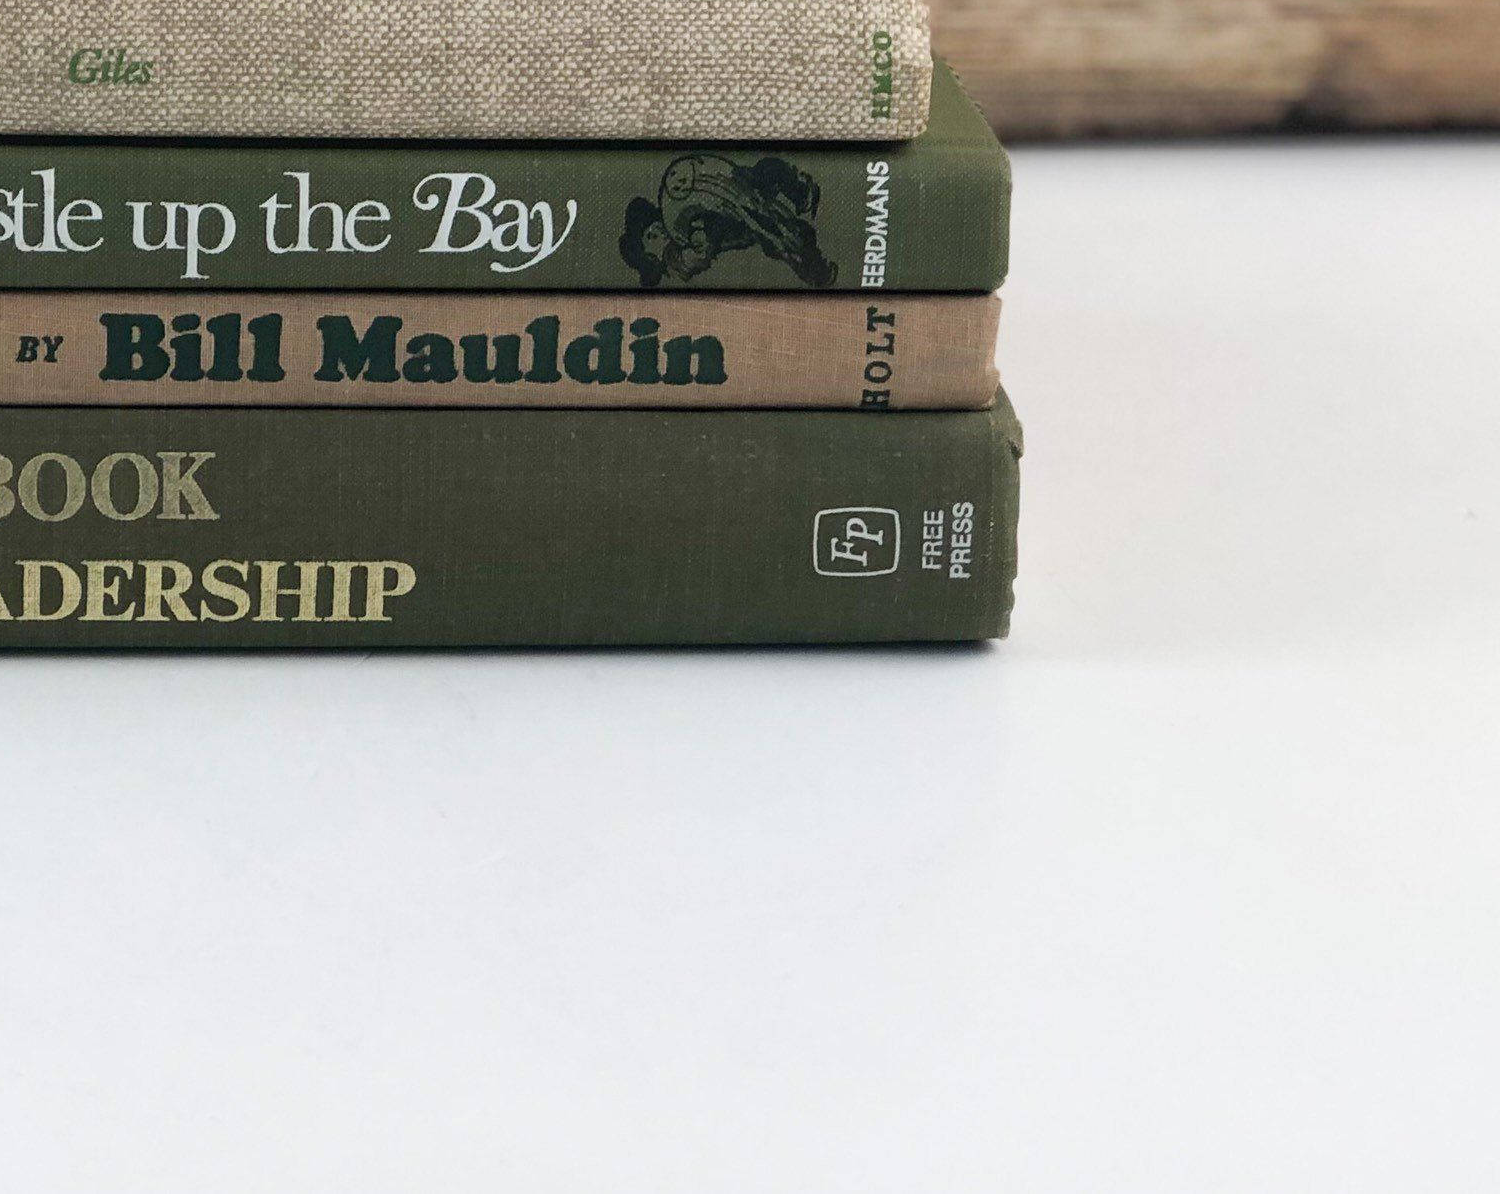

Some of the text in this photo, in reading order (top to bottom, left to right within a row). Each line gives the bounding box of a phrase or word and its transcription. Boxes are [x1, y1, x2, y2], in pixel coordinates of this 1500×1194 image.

[67, 47, 153, 86] Giles
[127, 200, 236, 280] up
[260, 171, 391, 253] the
[412, 172, 578, 273] Bay
[861, 161, 890, 288] EERDMANS
[16, 334, 64, 364] BY
[99, 312, 285, 382] Bill
[314, 314, 729, 385] Mauldin
[860, 306, 896, 406] HOLT
[921, 509, 944, 570] FREE
[949, 501, 975, 580] PRESS
